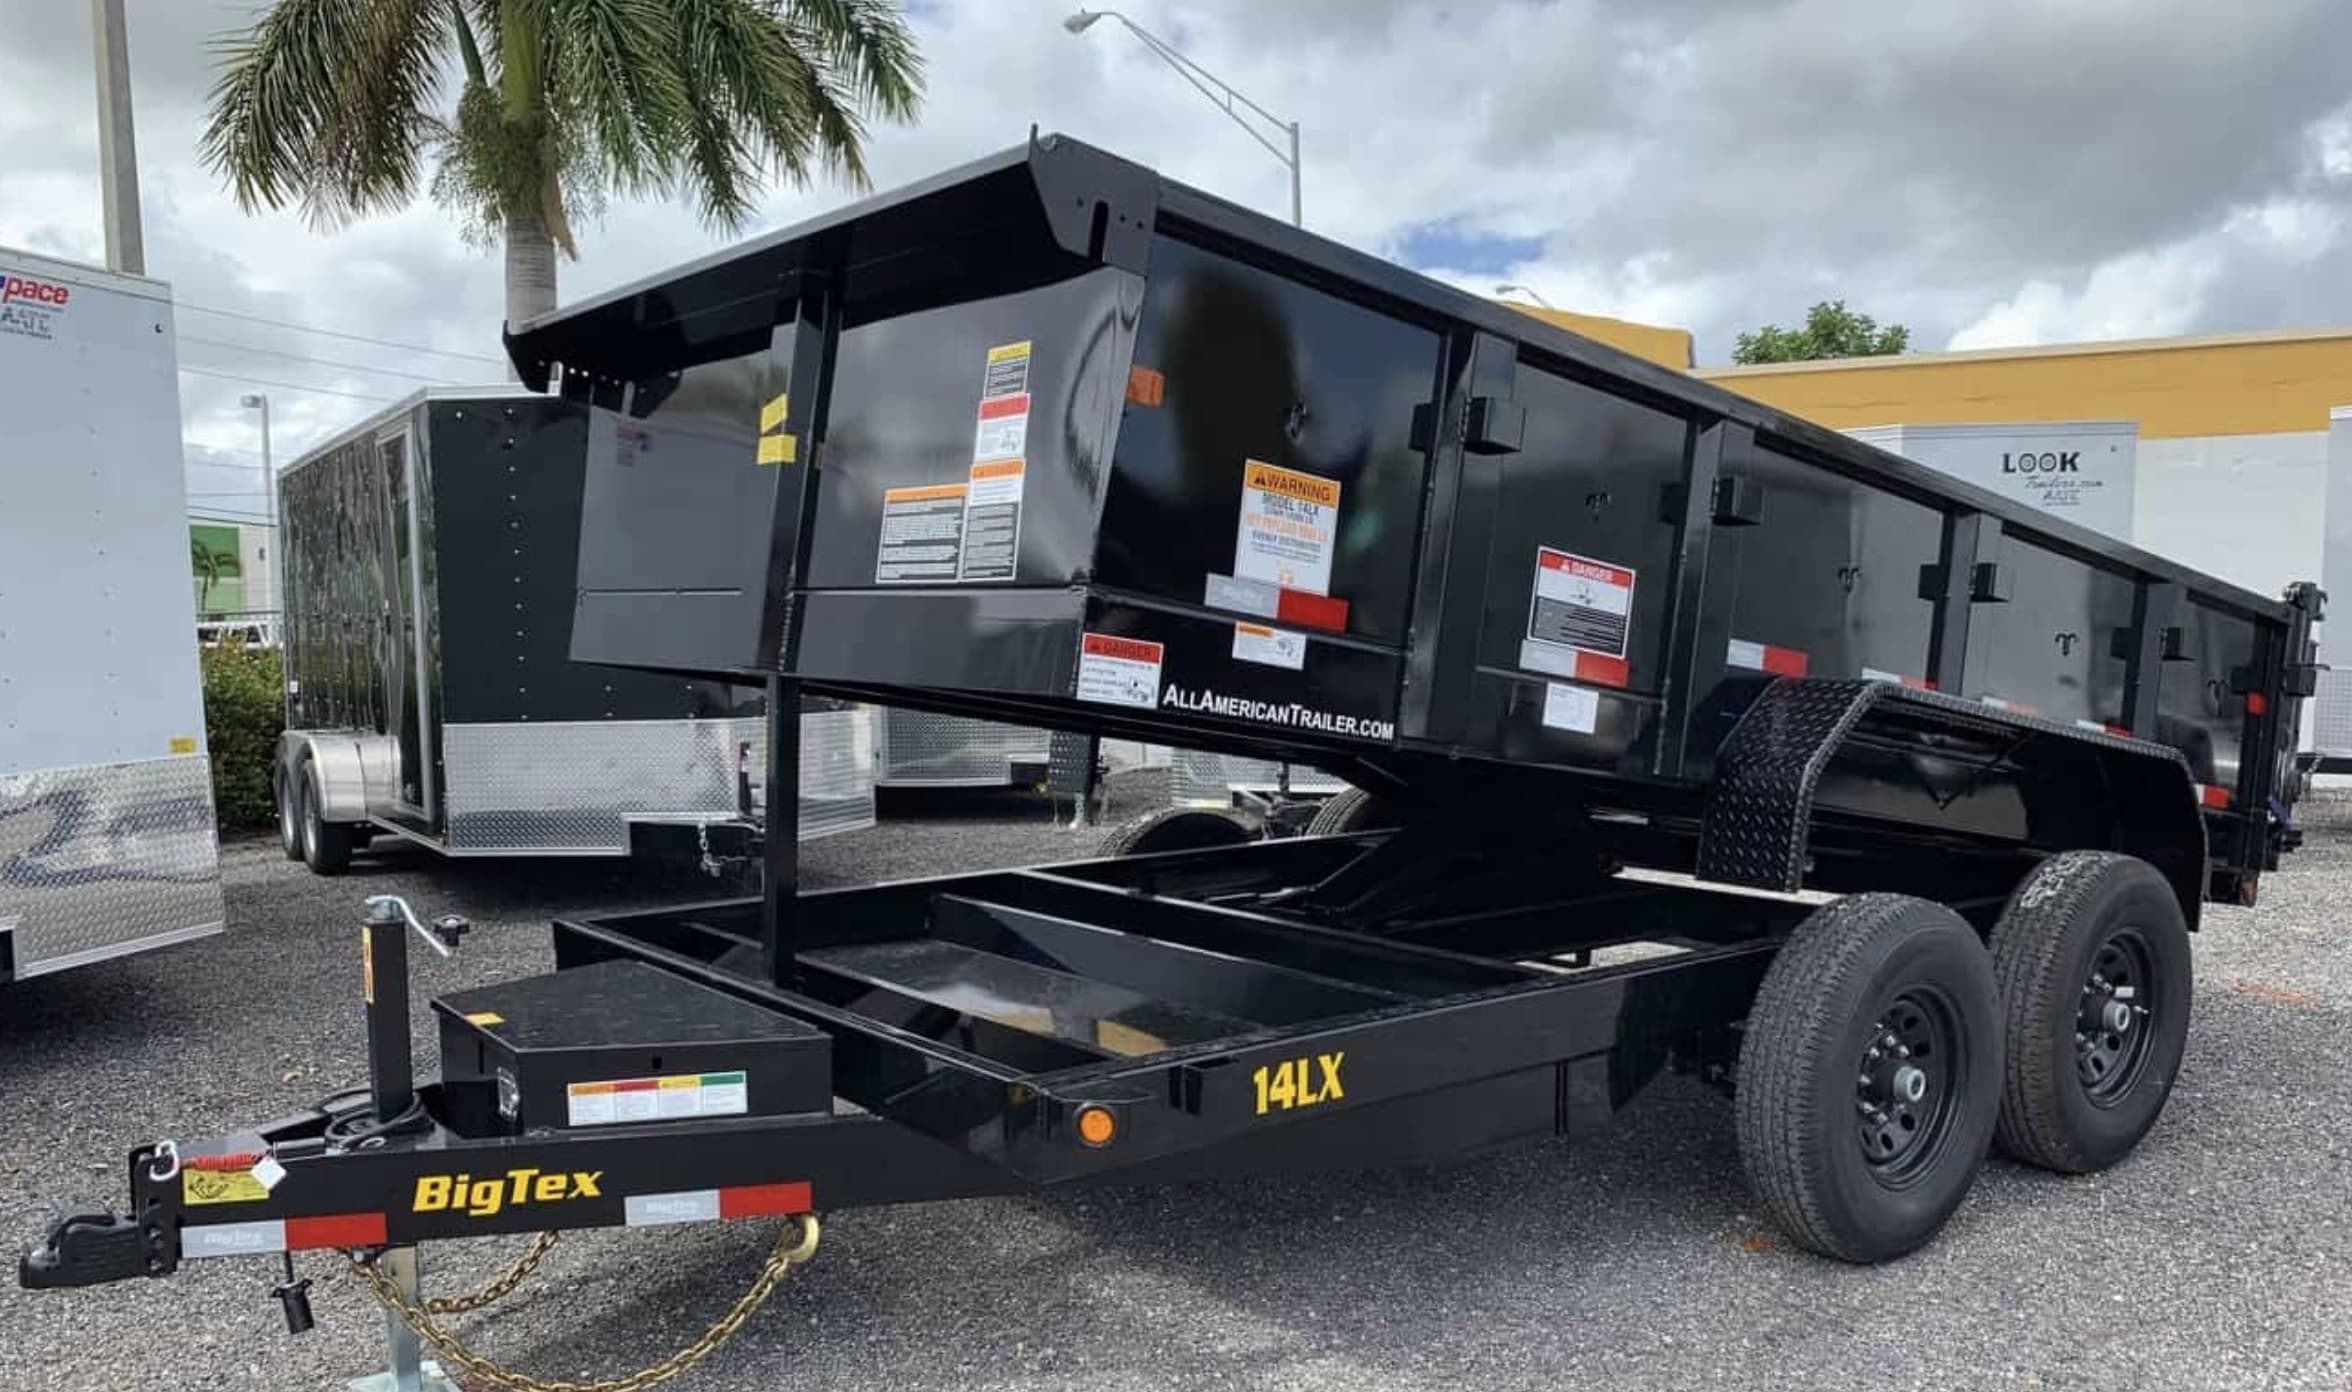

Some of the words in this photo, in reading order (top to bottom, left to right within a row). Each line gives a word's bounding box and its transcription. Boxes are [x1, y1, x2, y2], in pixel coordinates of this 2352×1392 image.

[2, 276, 69, 305] pace
[2003, 451, 2080, 473] LOOK
[1268, 472, 1331, 501] WARNING
[1571, 560, 1614, 581] DANGER
[1103, 641, 1152, 658] DANGER
[1252, 1051, 1345, 1115] 14LX
[412, 1168, 603, 1217] BigTex
